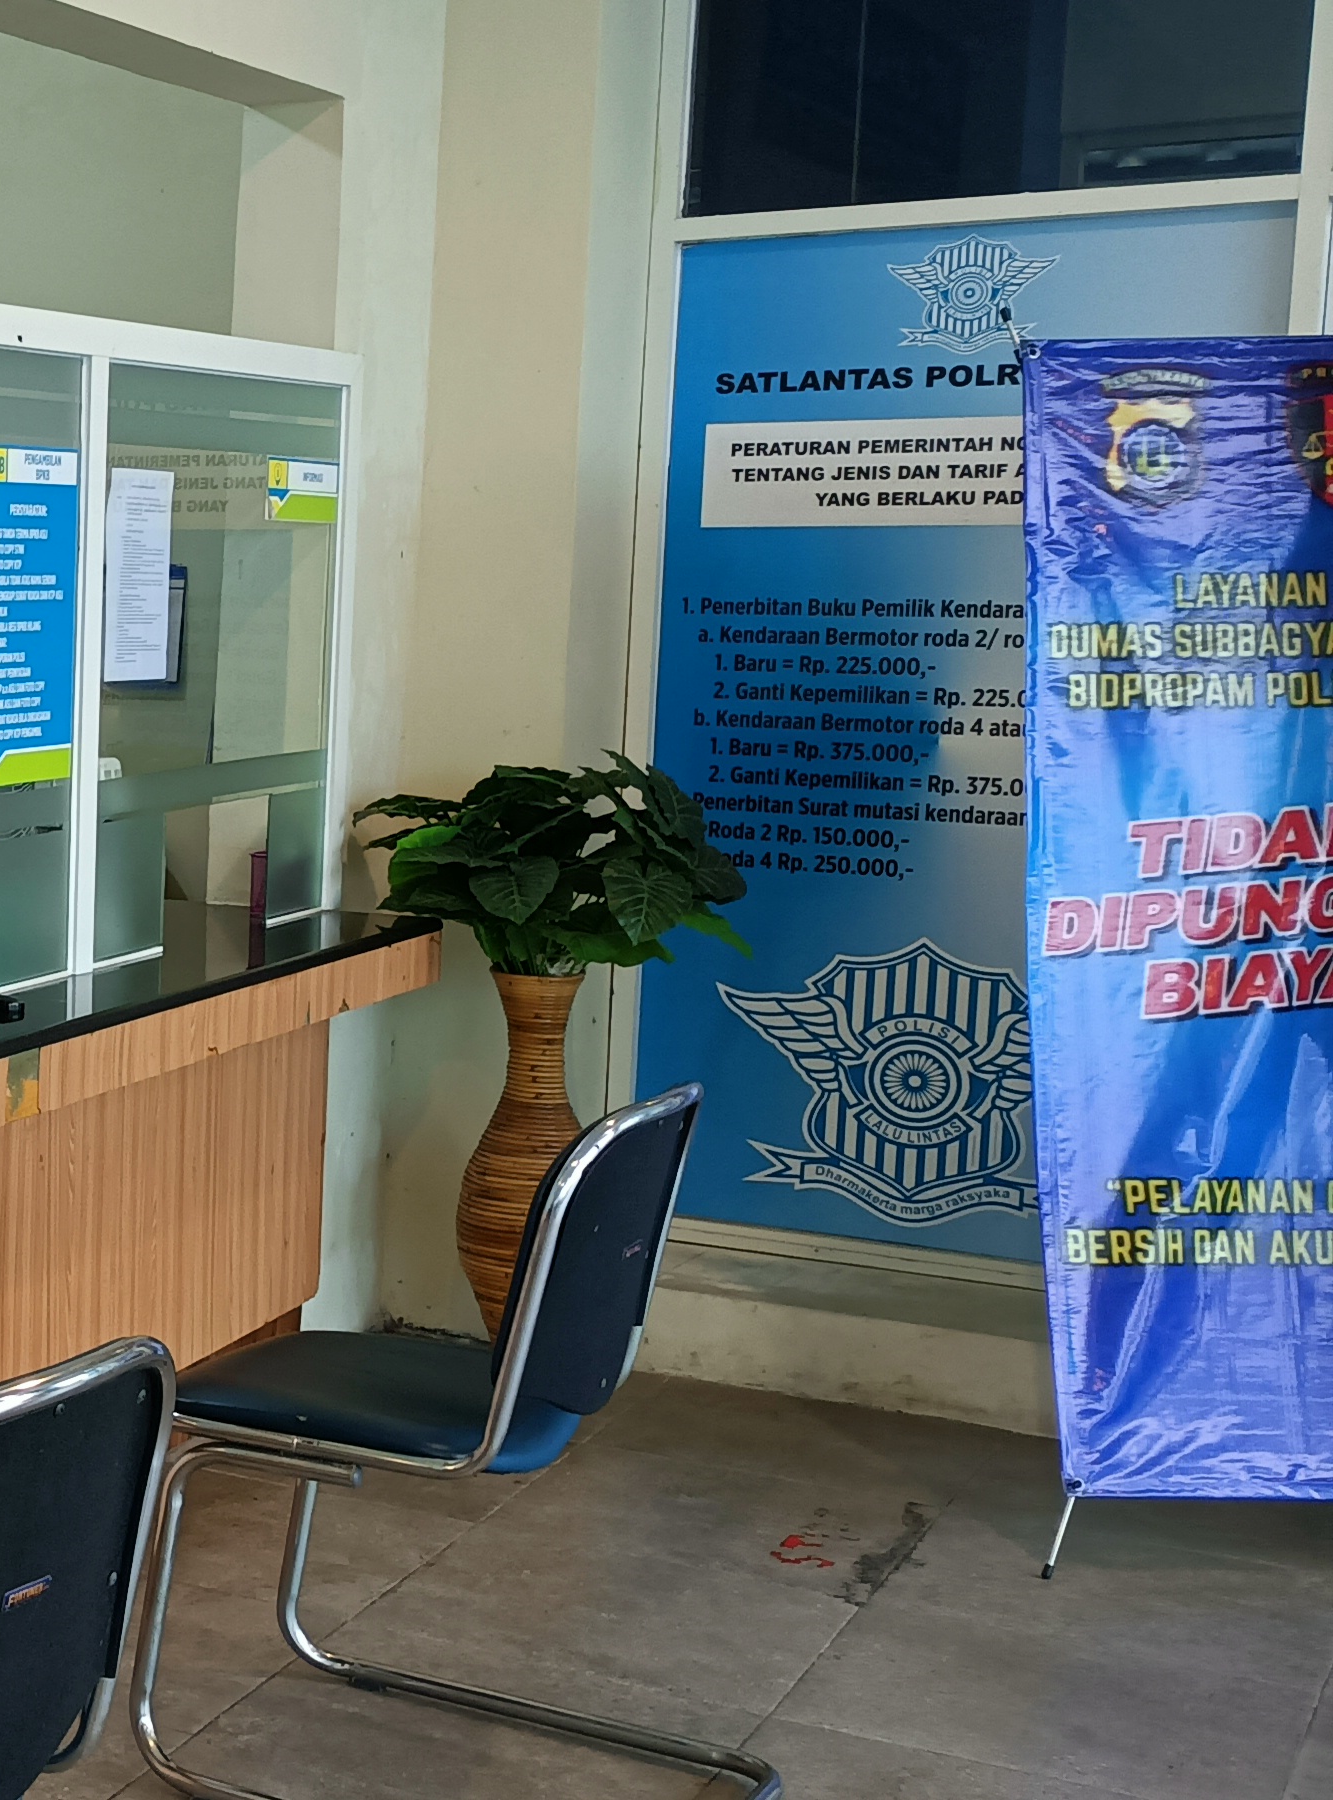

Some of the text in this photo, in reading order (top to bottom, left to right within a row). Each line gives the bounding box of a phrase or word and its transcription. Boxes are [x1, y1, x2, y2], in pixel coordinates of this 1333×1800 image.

[715, 363, 1020, 394] SATLANTAS POLR
[730, 436, 993, 457] PERATURAN PEMERINTAH
[731, 463, 1009, 483] TENTANG JENIS DAN TARIF
[815, 489, 1025, 507] YANG BERLAKU PAD
[1174, 571, 1327, 609] LAYANAN
[682, 597, 1026, 619] 1. Penerbitan Buku Pemilik Kendara
[698, 626, 1025, 650] a. Kendaraan Bermotor roda 2/ ro
[1049, 622, 1163, 659] DUMAS
[714, 653, 936, 680] 1. Baru = Rp. 225.000,-
[713, 682, 730, 699] 2.
[735, 682, 785, 701] Ganti
[790, 683, 910, 706] Kepemilikan
[915, 691, 928, 699] =
[933, 687, 966, 710] Rp.
[1068, 671, 1333, 709] BIDPROPAM POL
[694, 709, 1026, 738] b. Kendaraan Bermotor roda 4 ata
[710, 737, 930, 766] 1. Baru = Rp. 375.000,-
[708, 765, 1026, 797] 2. Ganti Kepemilikan = Rp. 375.0
[798, 798, 848, 818] Surat
[853, 802, 920, 821] mutasi
[708, 821, 910, 852] Roda 2 Rp. 150.000,-
[1127, 803, 1333, 879] TIDA
[759, 852, 914, 881] 4 Rp. 250.000,-
[876, 1019, 961, 1045] POLISI
[864, 1112, 963, 1144] LALU LINTAS
[900, 1204, 943, 1216] marga
[945, 1187, 1011, 1209] raksyaka
[1065, 1229, 1333, 1265] BERSIH DAN AKU
